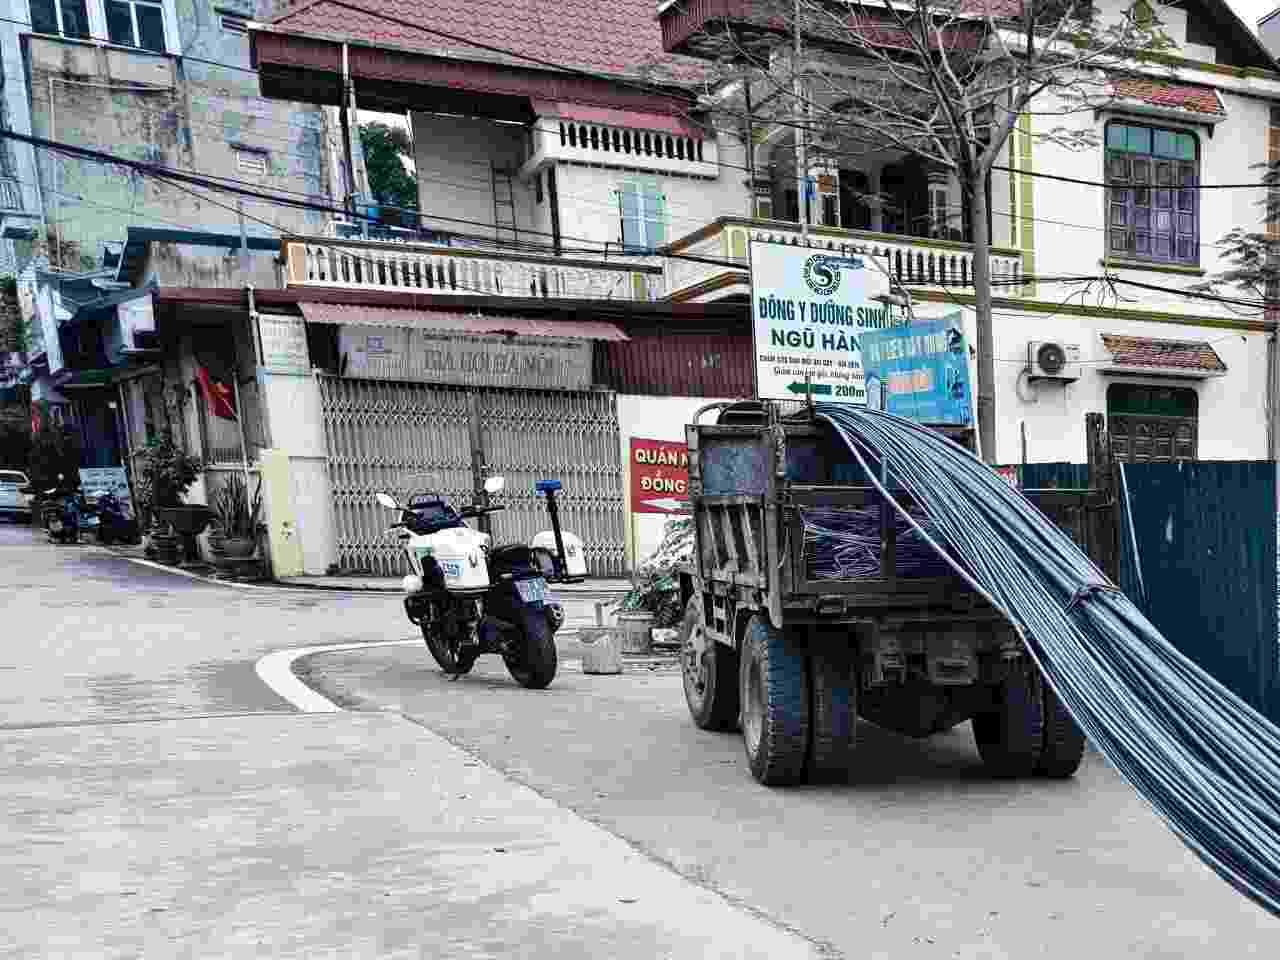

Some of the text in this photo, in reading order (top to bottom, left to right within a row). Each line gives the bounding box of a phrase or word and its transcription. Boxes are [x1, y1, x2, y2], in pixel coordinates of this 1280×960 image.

[799, 301, 806, 322] Y
[771, 327, 815, 348] NGŨ
[635, 446, 677, 465] QUÁN
